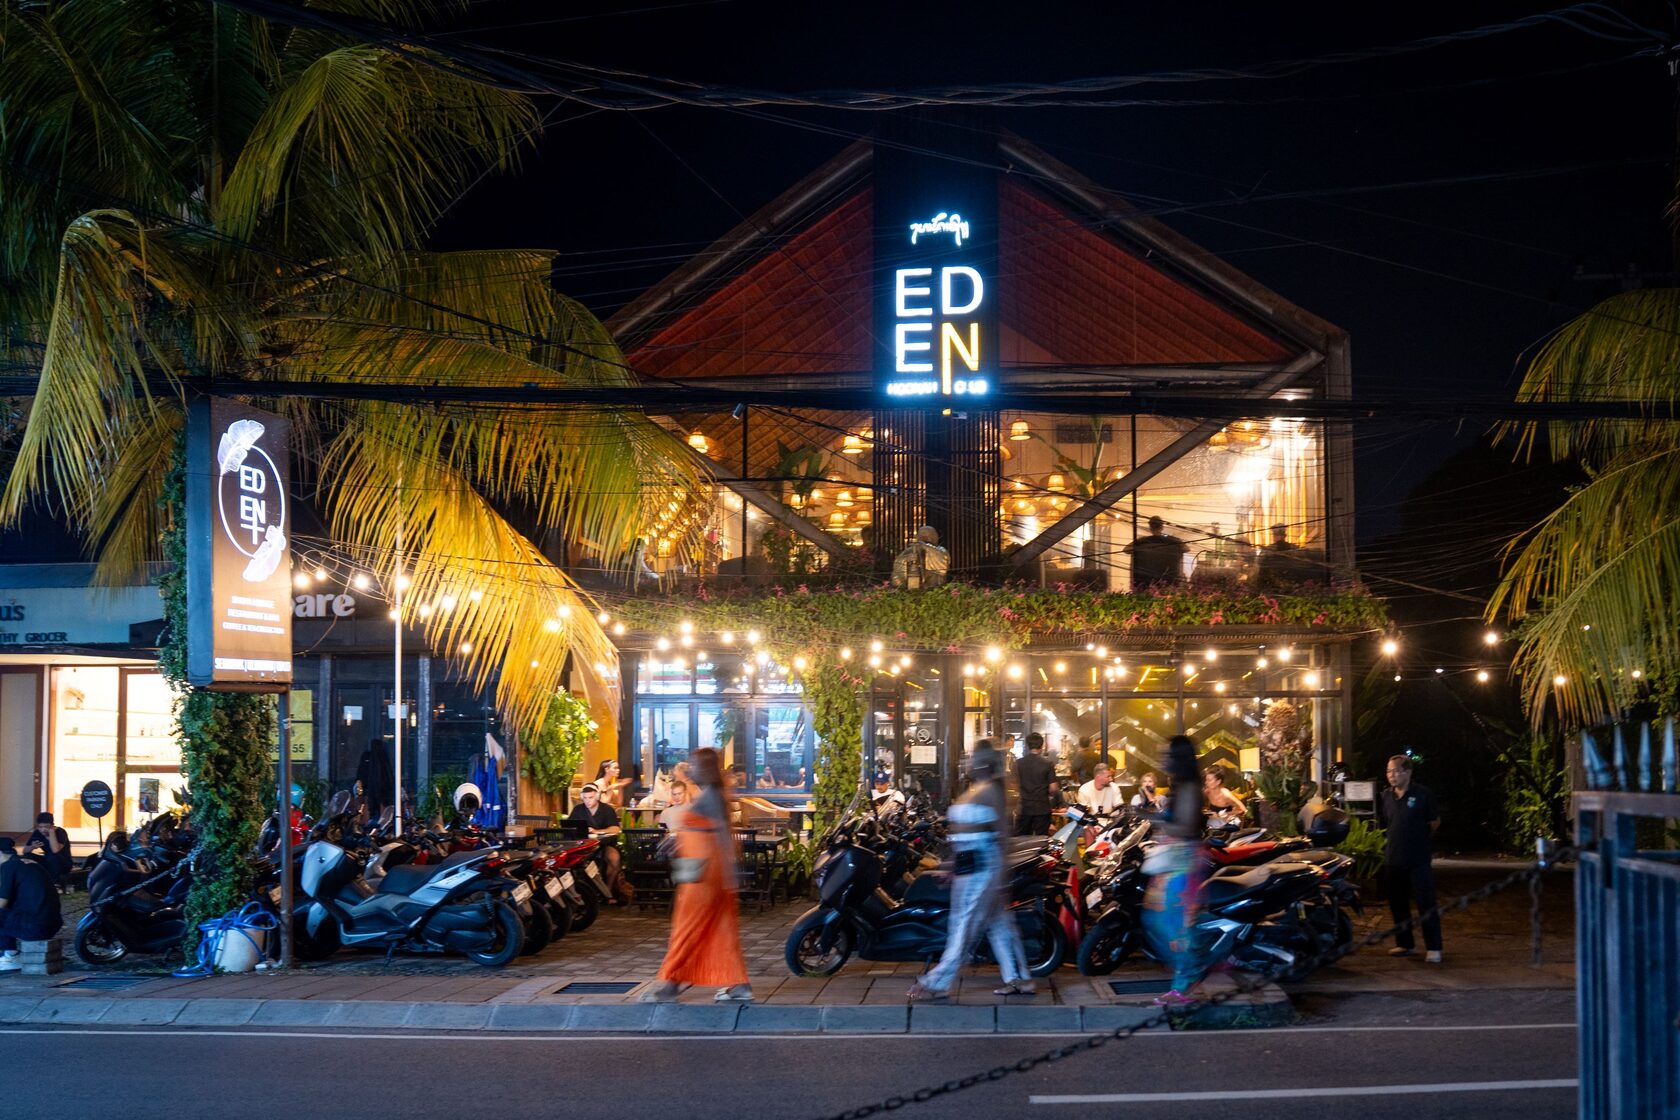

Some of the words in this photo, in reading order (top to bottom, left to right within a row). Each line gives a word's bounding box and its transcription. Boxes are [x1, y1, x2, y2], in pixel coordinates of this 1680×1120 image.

[895, 266, 984, 317] ED
[290, 593, 356, 617] are
[25, 631, 68, 643] GROCER
